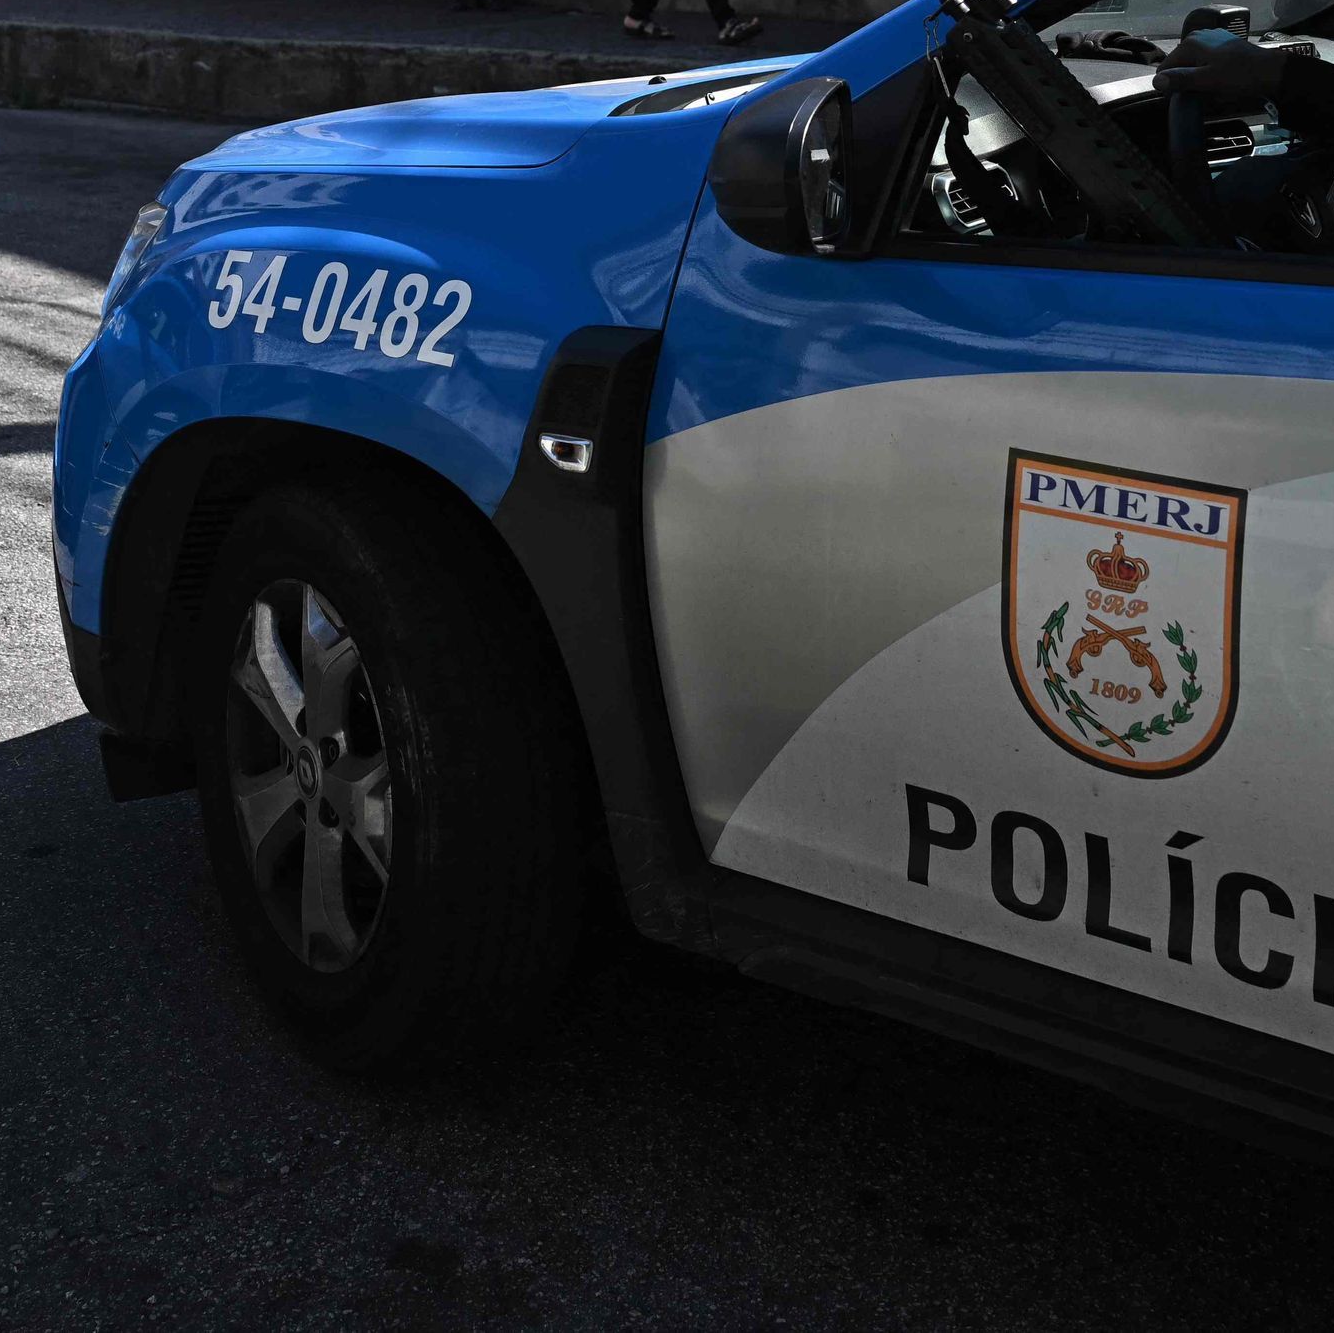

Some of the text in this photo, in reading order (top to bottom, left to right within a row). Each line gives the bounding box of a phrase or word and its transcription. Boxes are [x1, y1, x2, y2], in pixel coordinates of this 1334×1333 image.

[208, 249, 472, 368] 54-0482
[1024, 471, 1229, 536] PMERJ
[1089, 677, 1142, 705] 1809
